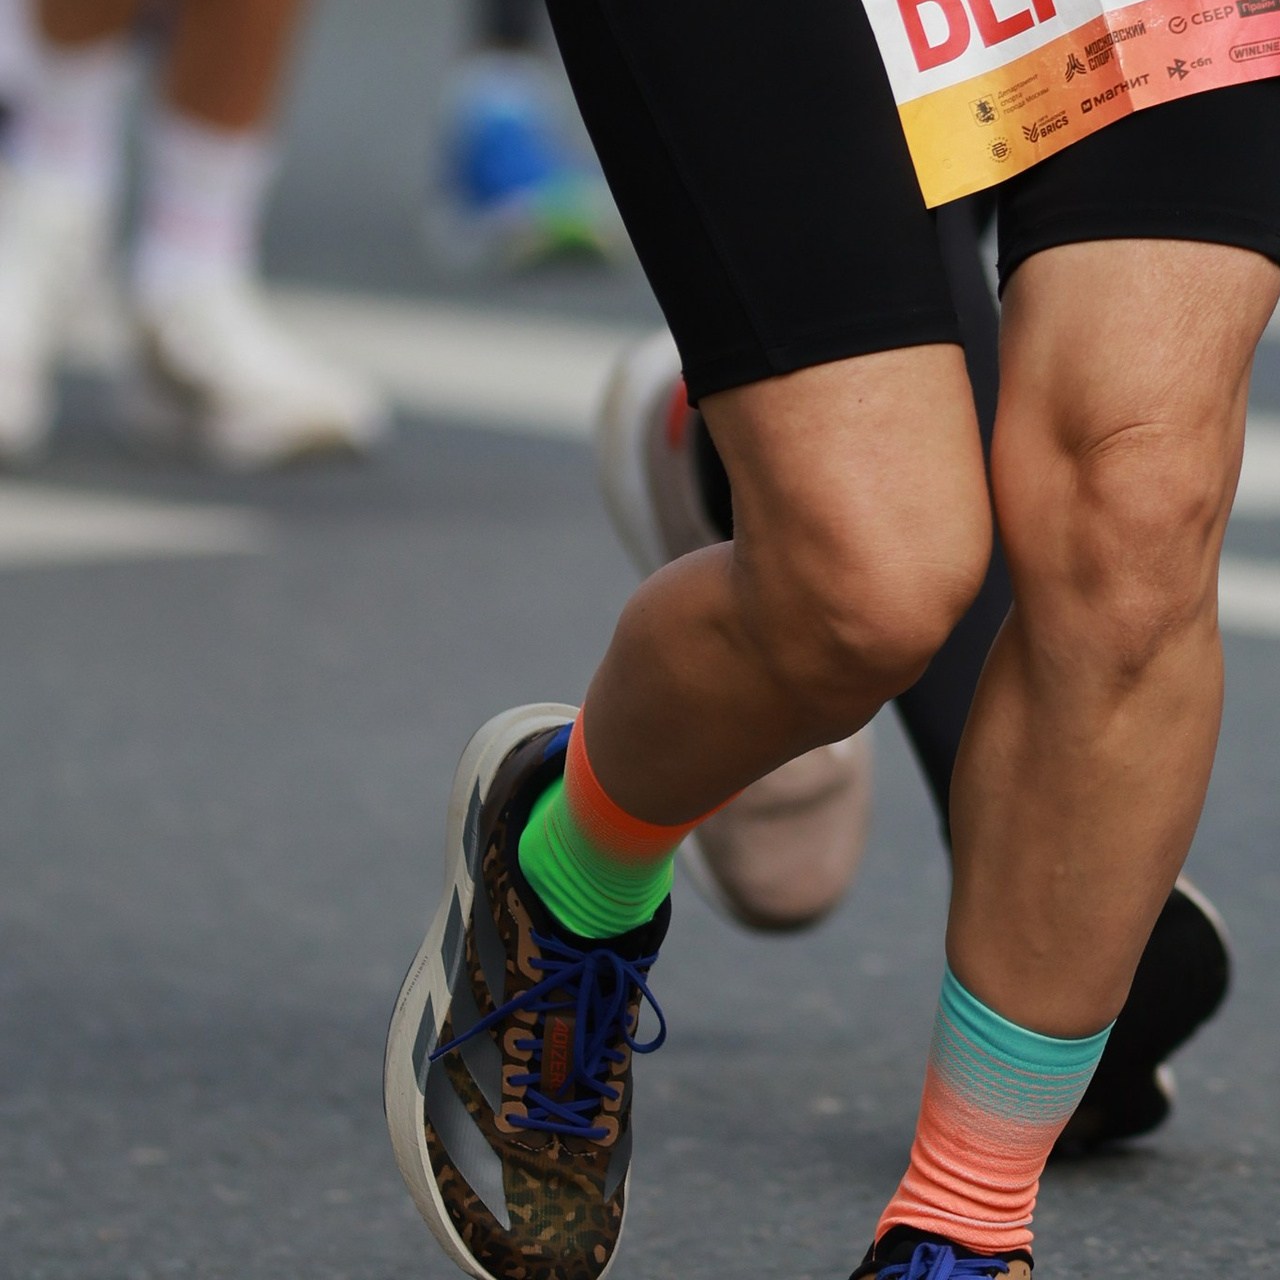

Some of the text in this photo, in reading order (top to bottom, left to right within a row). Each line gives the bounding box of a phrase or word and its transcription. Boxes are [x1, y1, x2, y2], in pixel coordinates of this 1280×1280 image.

[1191, 5, 1235, 26] СБЕР
[1084, 20, 1147, 58] МОСКОВСКИЙ
[1233, 41, 1280, 60] WINLINE
[1088, 49, 1115, 72] СПОРТ
[1190, 56, 1213, 69] сбп
[998, 73, 1039, 100] Департамент
[1040, 115, 1069, 139] BRICS
